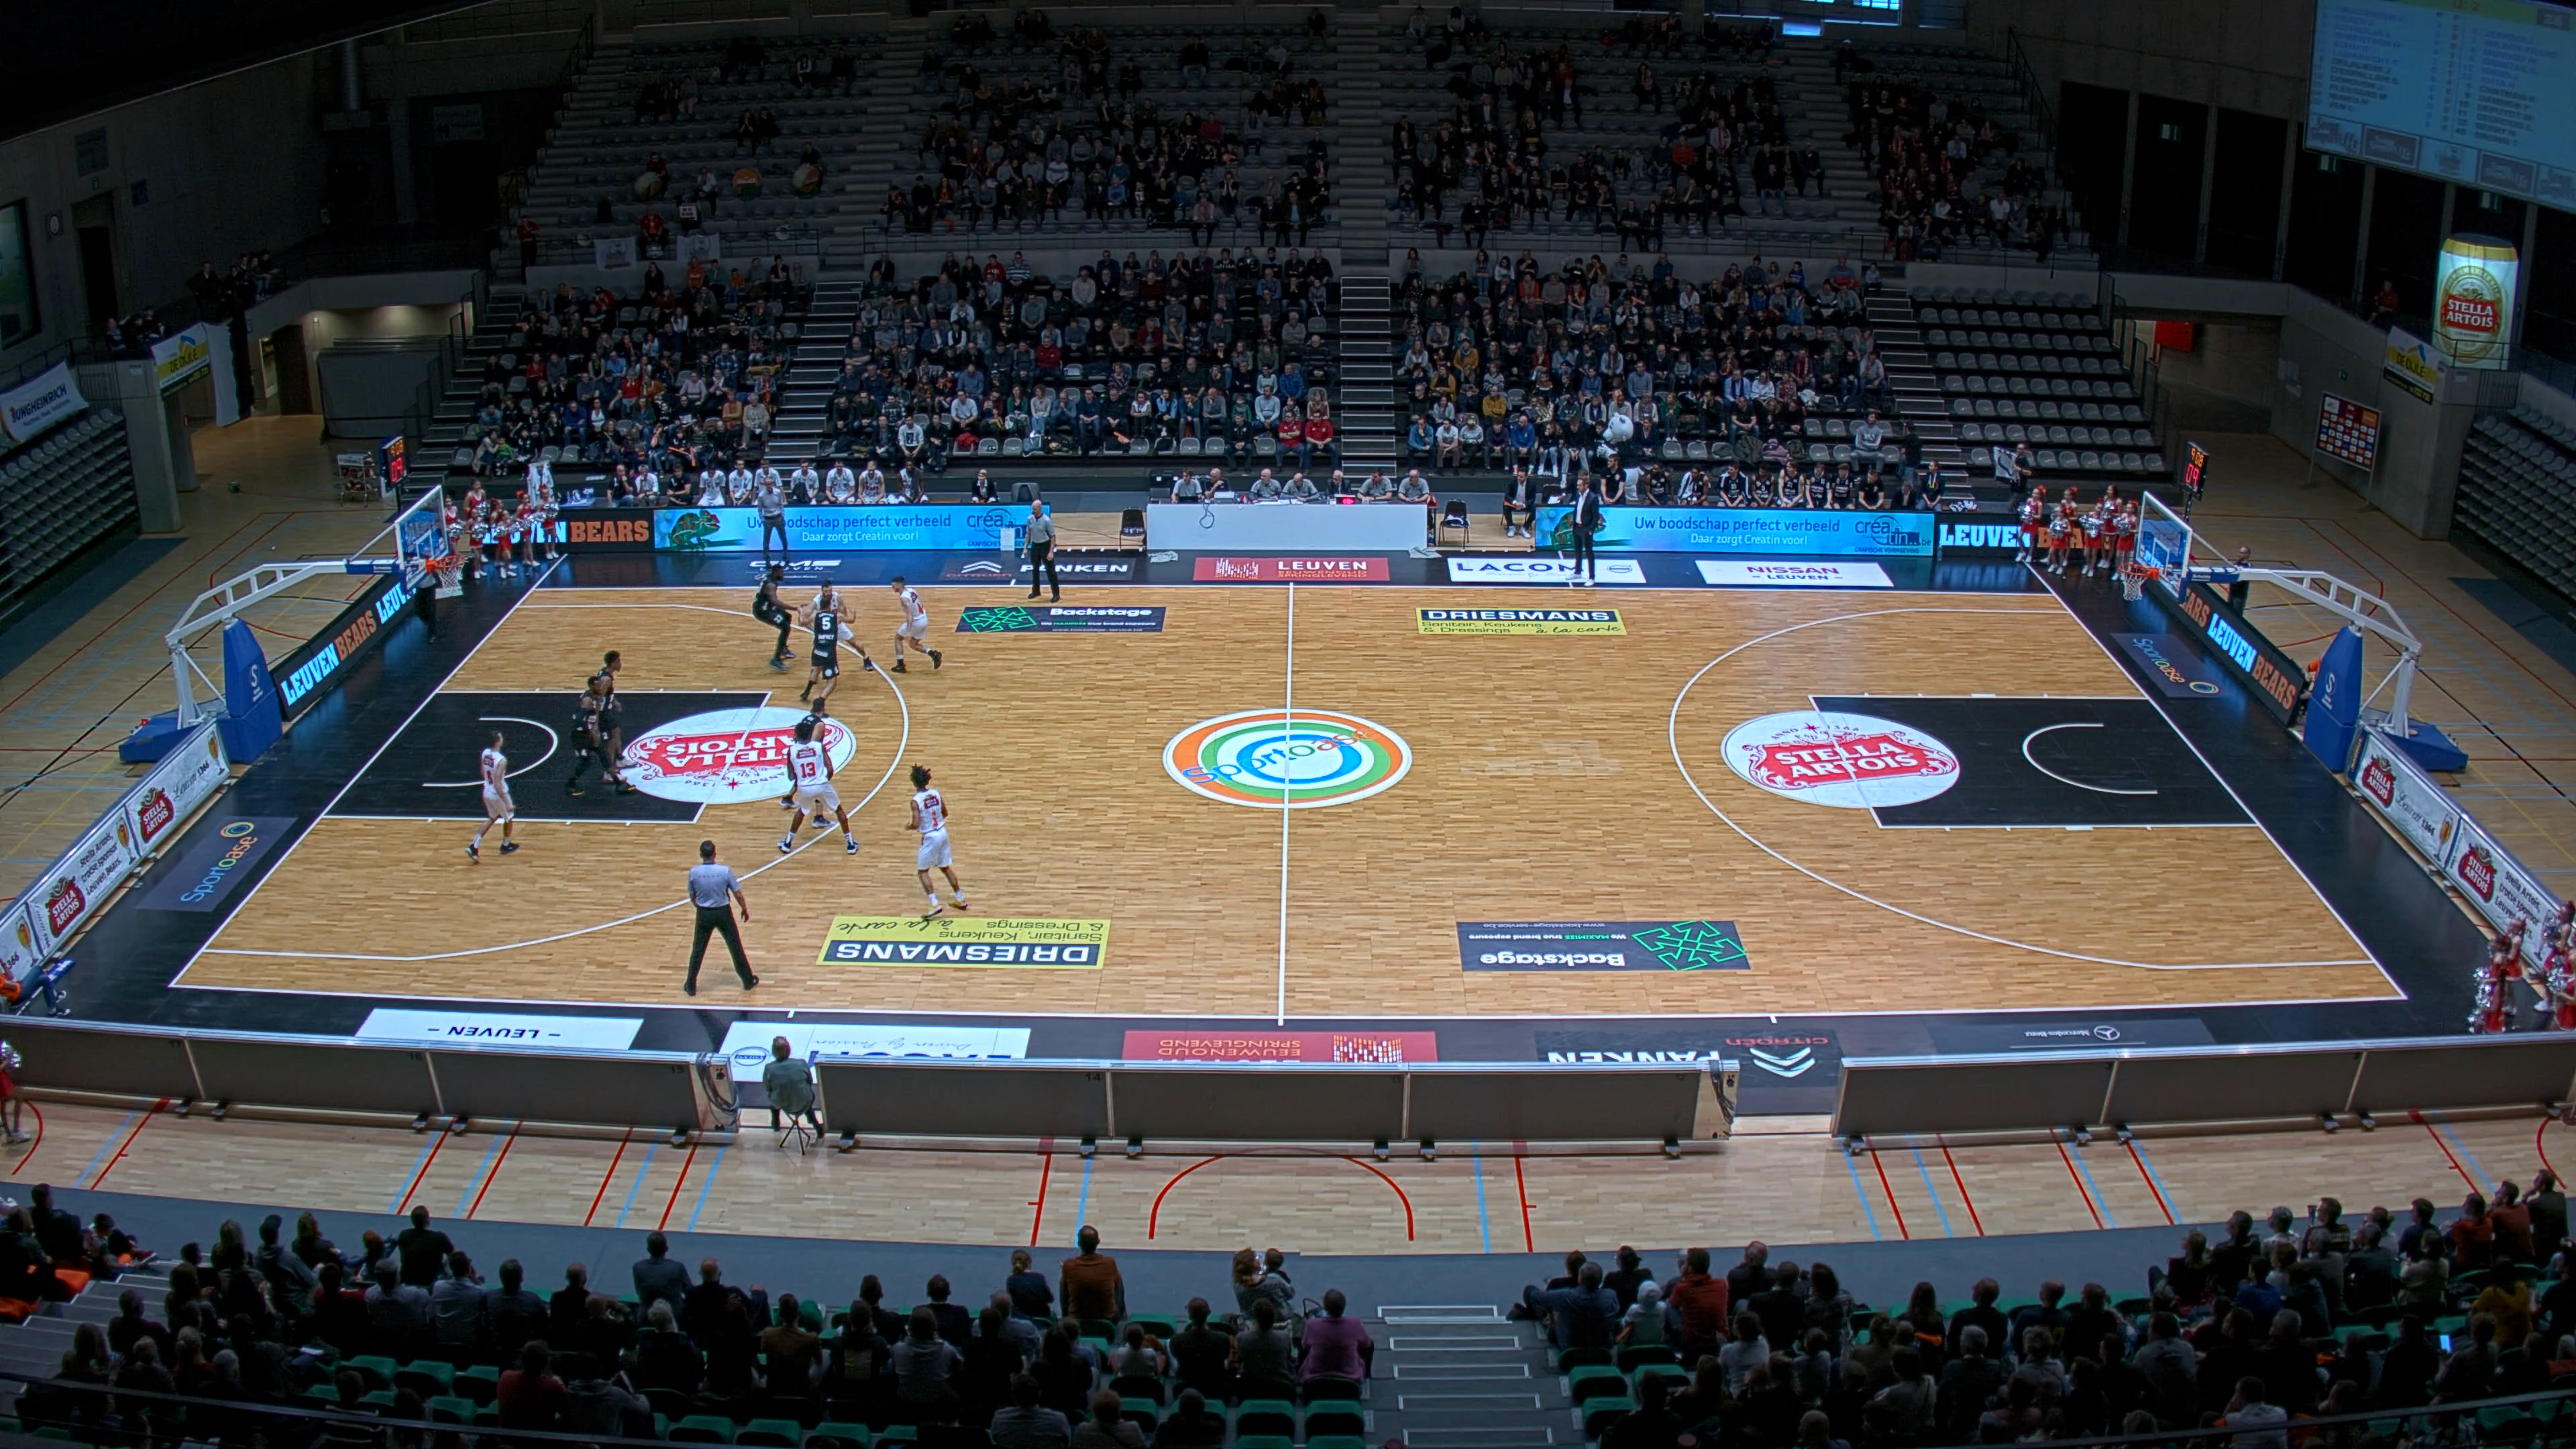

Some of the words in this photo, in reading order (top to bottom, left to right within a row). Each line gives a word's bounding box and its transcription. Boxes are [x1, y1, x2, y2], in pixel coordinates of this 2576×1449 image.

[2448, 299, 2493, 316] STELLA
[2447, 312, 2493, 327] ARTOIS
[9, 383, 67, 423] JUNGHEINRICH
[785, 515, 839, 531] odschap
[843, 515, 892, 531] perfect
[894, 514, 951, 527] verbeeld
[1634, 517, 1656, 529] Uw
[1659, 516, 1730, 533] boodschap
[1732, 517, 1781, 533] perfect
[1784, 519, 1841, 532] verbeeld
[570, 521, 649, 542] BEARS
[802, 532, 825, 541] Daar
[827, 532, 853, 544] zorgt
[855, 531, 891, 541] Creatin
[893, 531, 918, 541] voor!
[1690, 533, 1713, 544] Daar
[1715, 534, 1743, 547] zorgt
[1744, 534, 1778, 545] Creatin
[1782, 535, 1808, 545] voor!
[1278, 561, 1367, 570] LEUVEN
[1747, 566, 1839, 574] NISSAN
[1050, 608, 1152, 617] Backstage
[1428, 610, 1610, 621] DRIESMANS
[822, 617, 831, 630] 5
[1552, 626, 1572, 634] la
[1576, 624, 1621, 633] carte
[280, 642, 341, 706] LEUVEN
[333, 609, 377, 661] BEARS
[2133, 638, 2186, 684] Sportoase
[2206, 612, 2257, 672] LEUVEN
[2251, 654, 2298, 710] BEARS
[666, 735, 796, 755] ARTOIS
[1775, 742, 1906, 765] STELLA
[197, 760, 210, 777] 1366
[800, 762, 816, 779] 13
[1790, 754, 1919, 777] ARTOIS
[2370, 766, 2391, 788] STELLA
[2367, 776, 2389, 800] ARTOIS
[143, 800, 166, 824] STELLA
[146, 808, 168, 835] ARTOIS
[2421, 818, 2436, 837] 1366
[80, 845, 97, 867] Stella
[97, 843, 119, 868] sponsor
[180, 835, 259, 903] Sportoase
[2468, 855, 2491, 884] STELLA
[85, 871, 107, 896] Leuven
[2463, 865, 2489, 894] ARTOIS
[2505, 870, 2522, 893] Stella
[52, 888, 77, 918] STELLA
[56, 898, 80, 928] ARTOIS
[2516, 901, 2540, 926] sponsor
[837, 921, 898, 934] carte
[903, 919, 930, 932] la
[986, 921, 1080, 932] Dressings
[1089, 922, 1104, 931] &
[939, 930, 1017, 941] Keukens
[1028, 931, 1103, 942] Sanitair,
[836, 943, 1090, 962] DRIESMANS
[1480, 950, 1625, 967] Backstage
[447, 1026, 540, 1038] LEUVEN
[1158, 1047, 1301, 1057] EEUWENOUD
[1159, 1039, 1301, 1048] SPRINGLEVEND
[1085, 1073, 1101, 1081] 14
